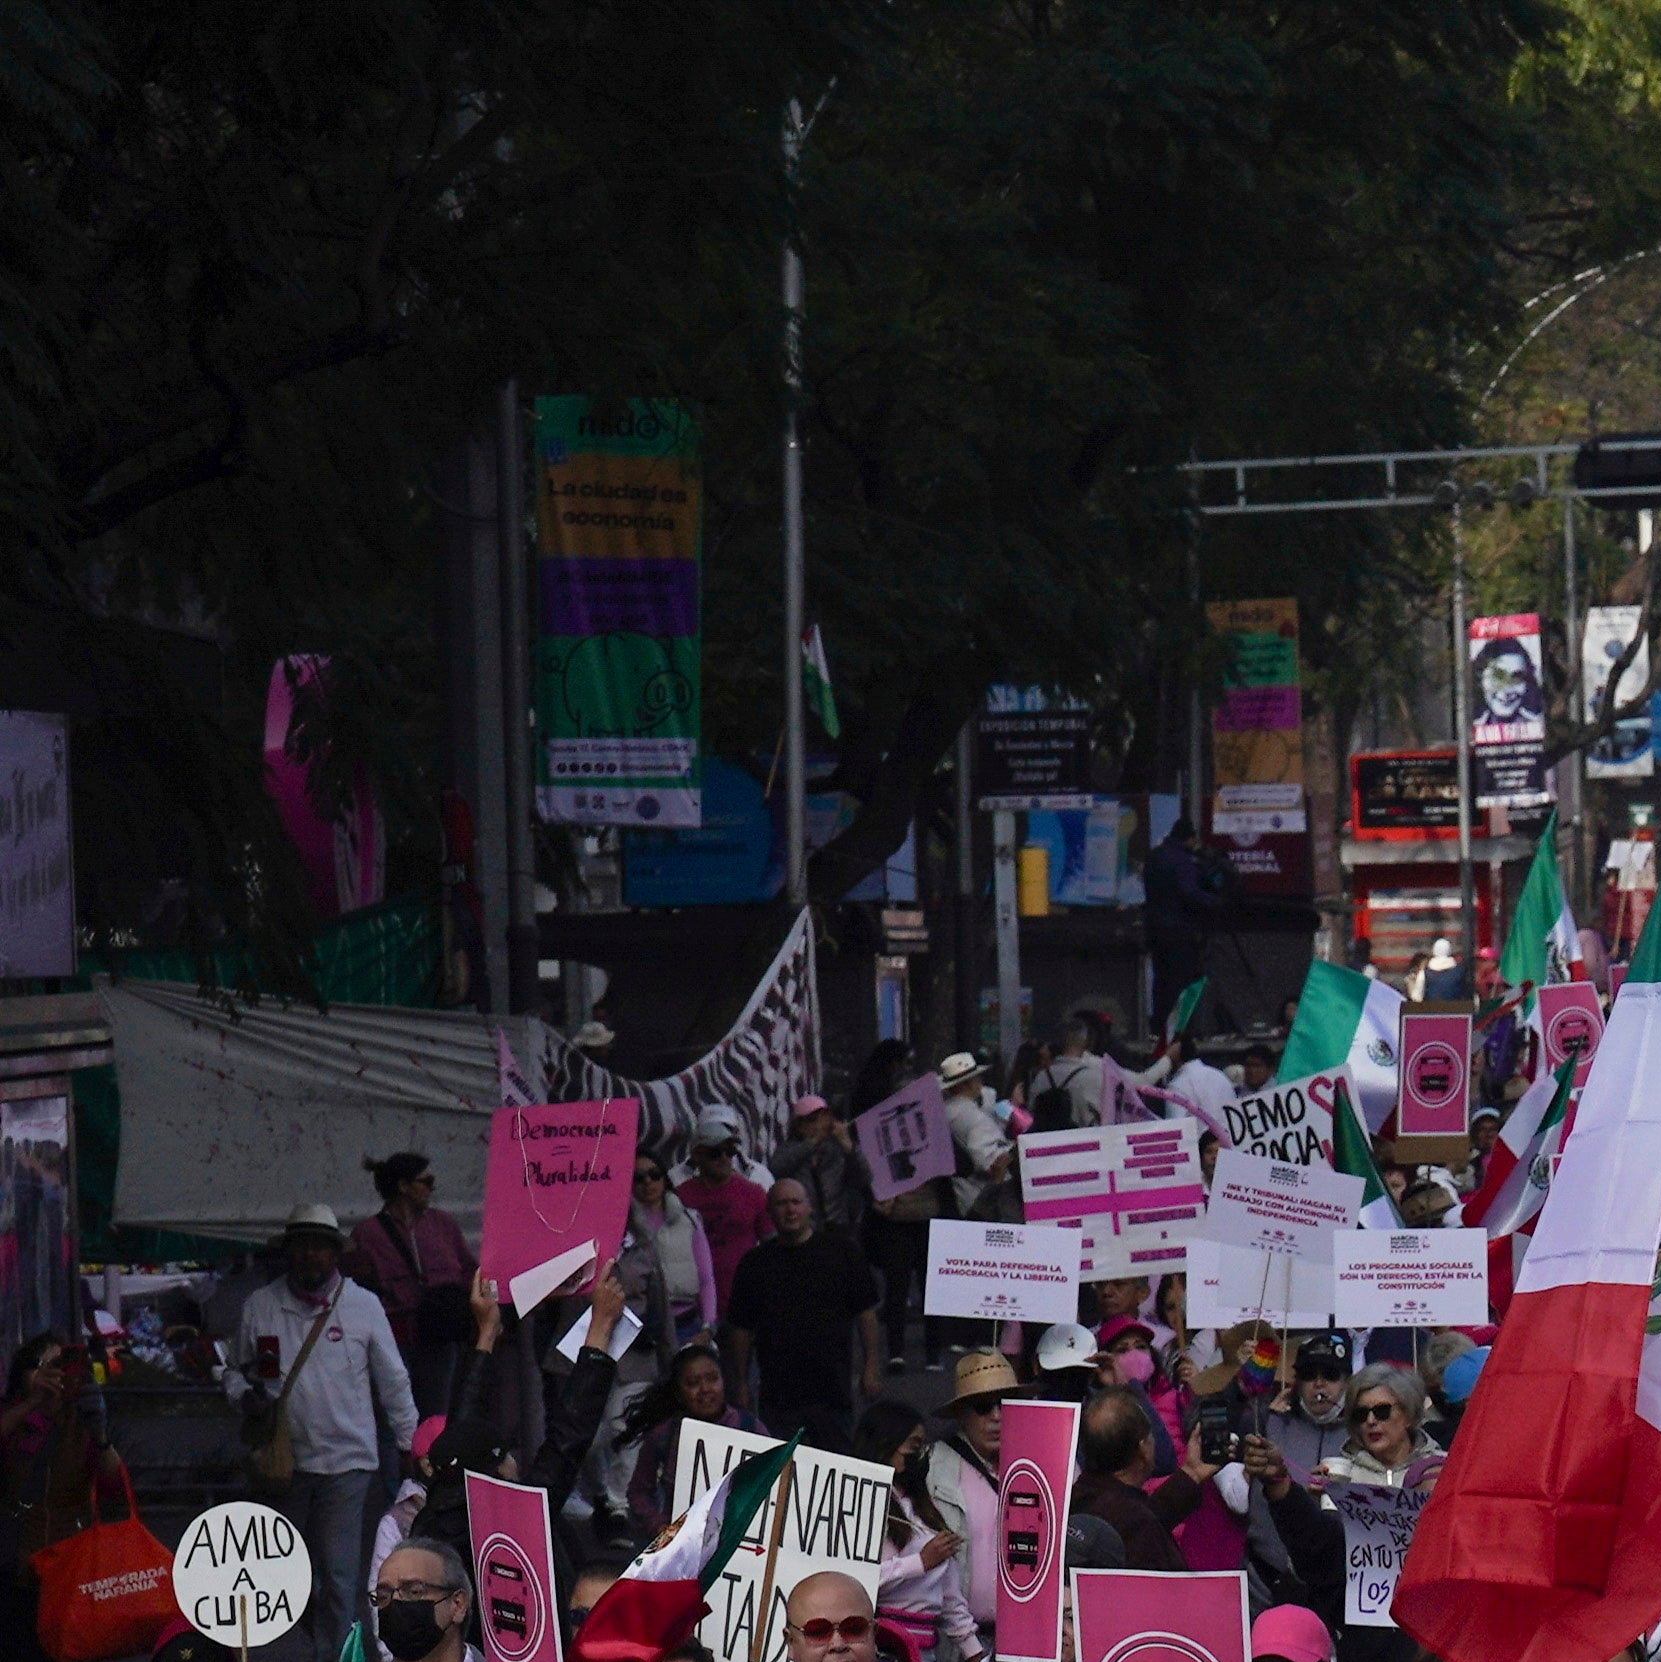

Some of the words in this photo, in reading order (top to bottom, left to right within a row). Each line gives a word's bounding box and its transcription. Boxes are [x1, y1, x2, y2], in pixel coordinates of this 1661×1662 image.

[1222, 1087, 1306, 1146] DEMO
[945, 1258, 972, 1268] VOTA
[972, 1260, 998, 1269] PARA
[1050, 1264, 1062, 1273] LA
[1349, 1262, 1366, 1271] LOS
[1369, 1262, 1427, 1270] PROGRAMAS
[1429, 1261, 1474, 1270] SOCIALES
[938, 1267, 1000, 1279] DEMOCRACIA
[1023, 1273, 1069, 1284] LIBERTAD
[1339, 1273, 1359, 1281] SON
[1361, 1272, 1374, 1280] UN
[1456, 1272, 1469, 1280] EN
[1471, 1272, 1484, 1280] LA
[1377, 1280, 1446, 1290] CONSTITUCIÓN
[184, 1514, 295, 1569] AMLO
[233, 1567, 257, 1591] A
[194, 1589, 293, 1629] CUBA
